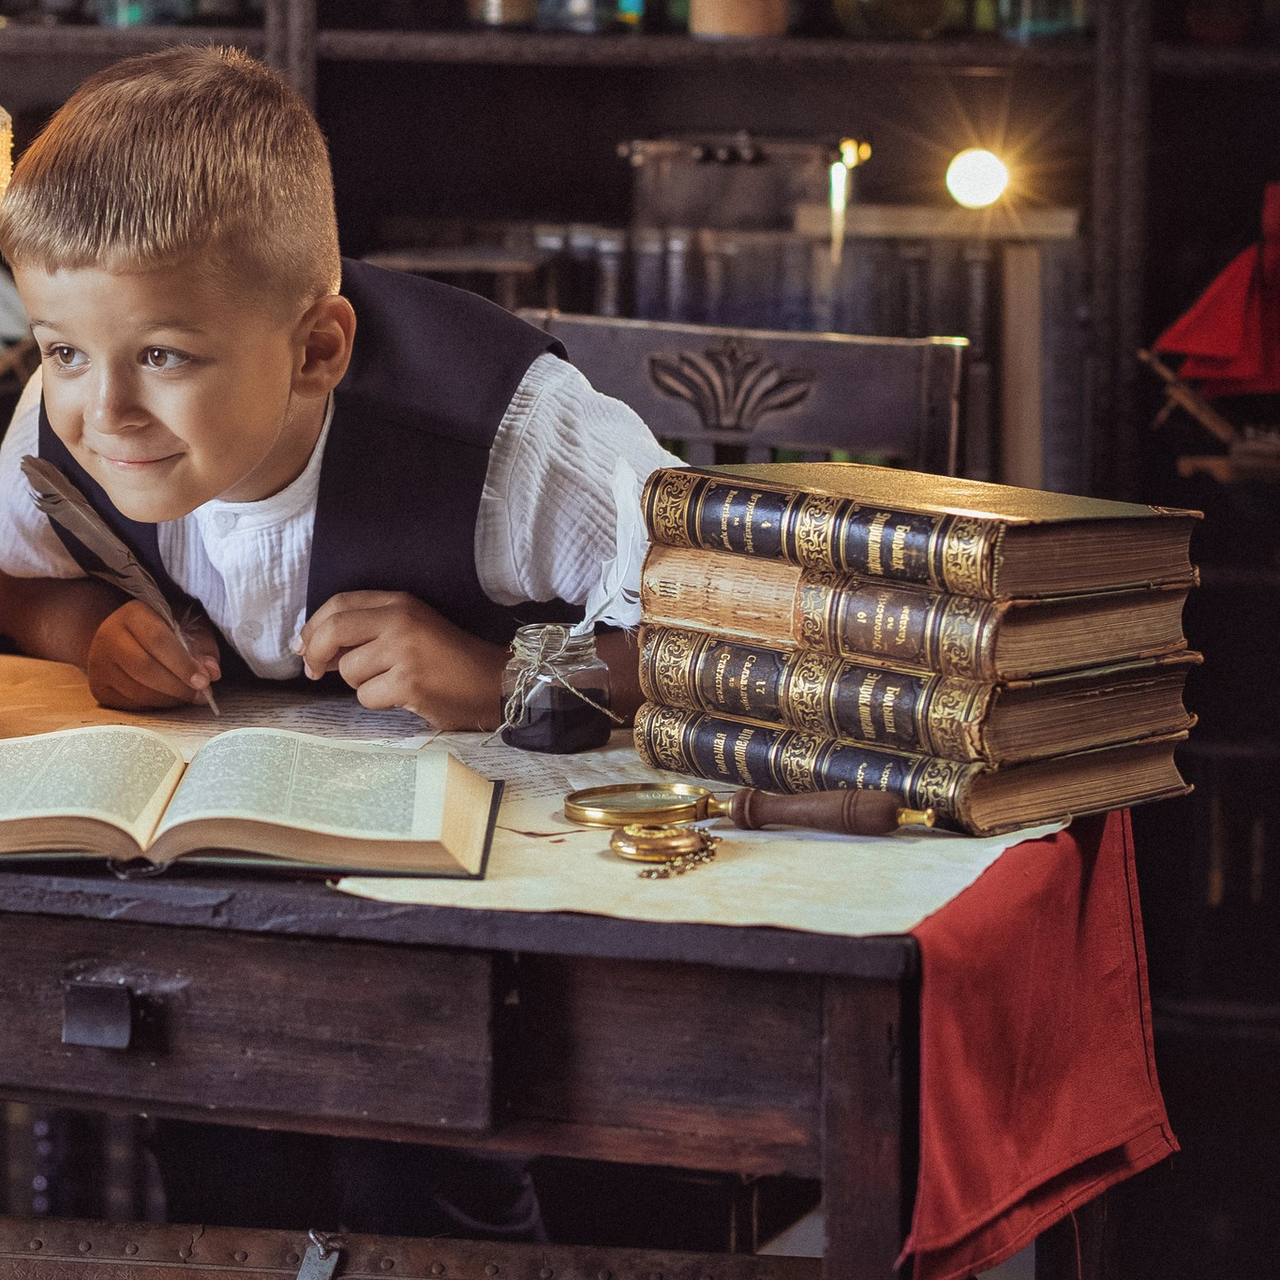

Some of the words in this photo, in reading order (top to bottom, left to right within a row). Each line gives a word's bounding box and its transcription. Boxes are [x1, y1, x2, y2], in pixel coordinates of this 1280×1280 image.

[856, 611, 868, 624] 19
[755, 680, 767, 694] 17
[882, 686, 900, 733] Большая
[712, 732, 729, 775] Большая
